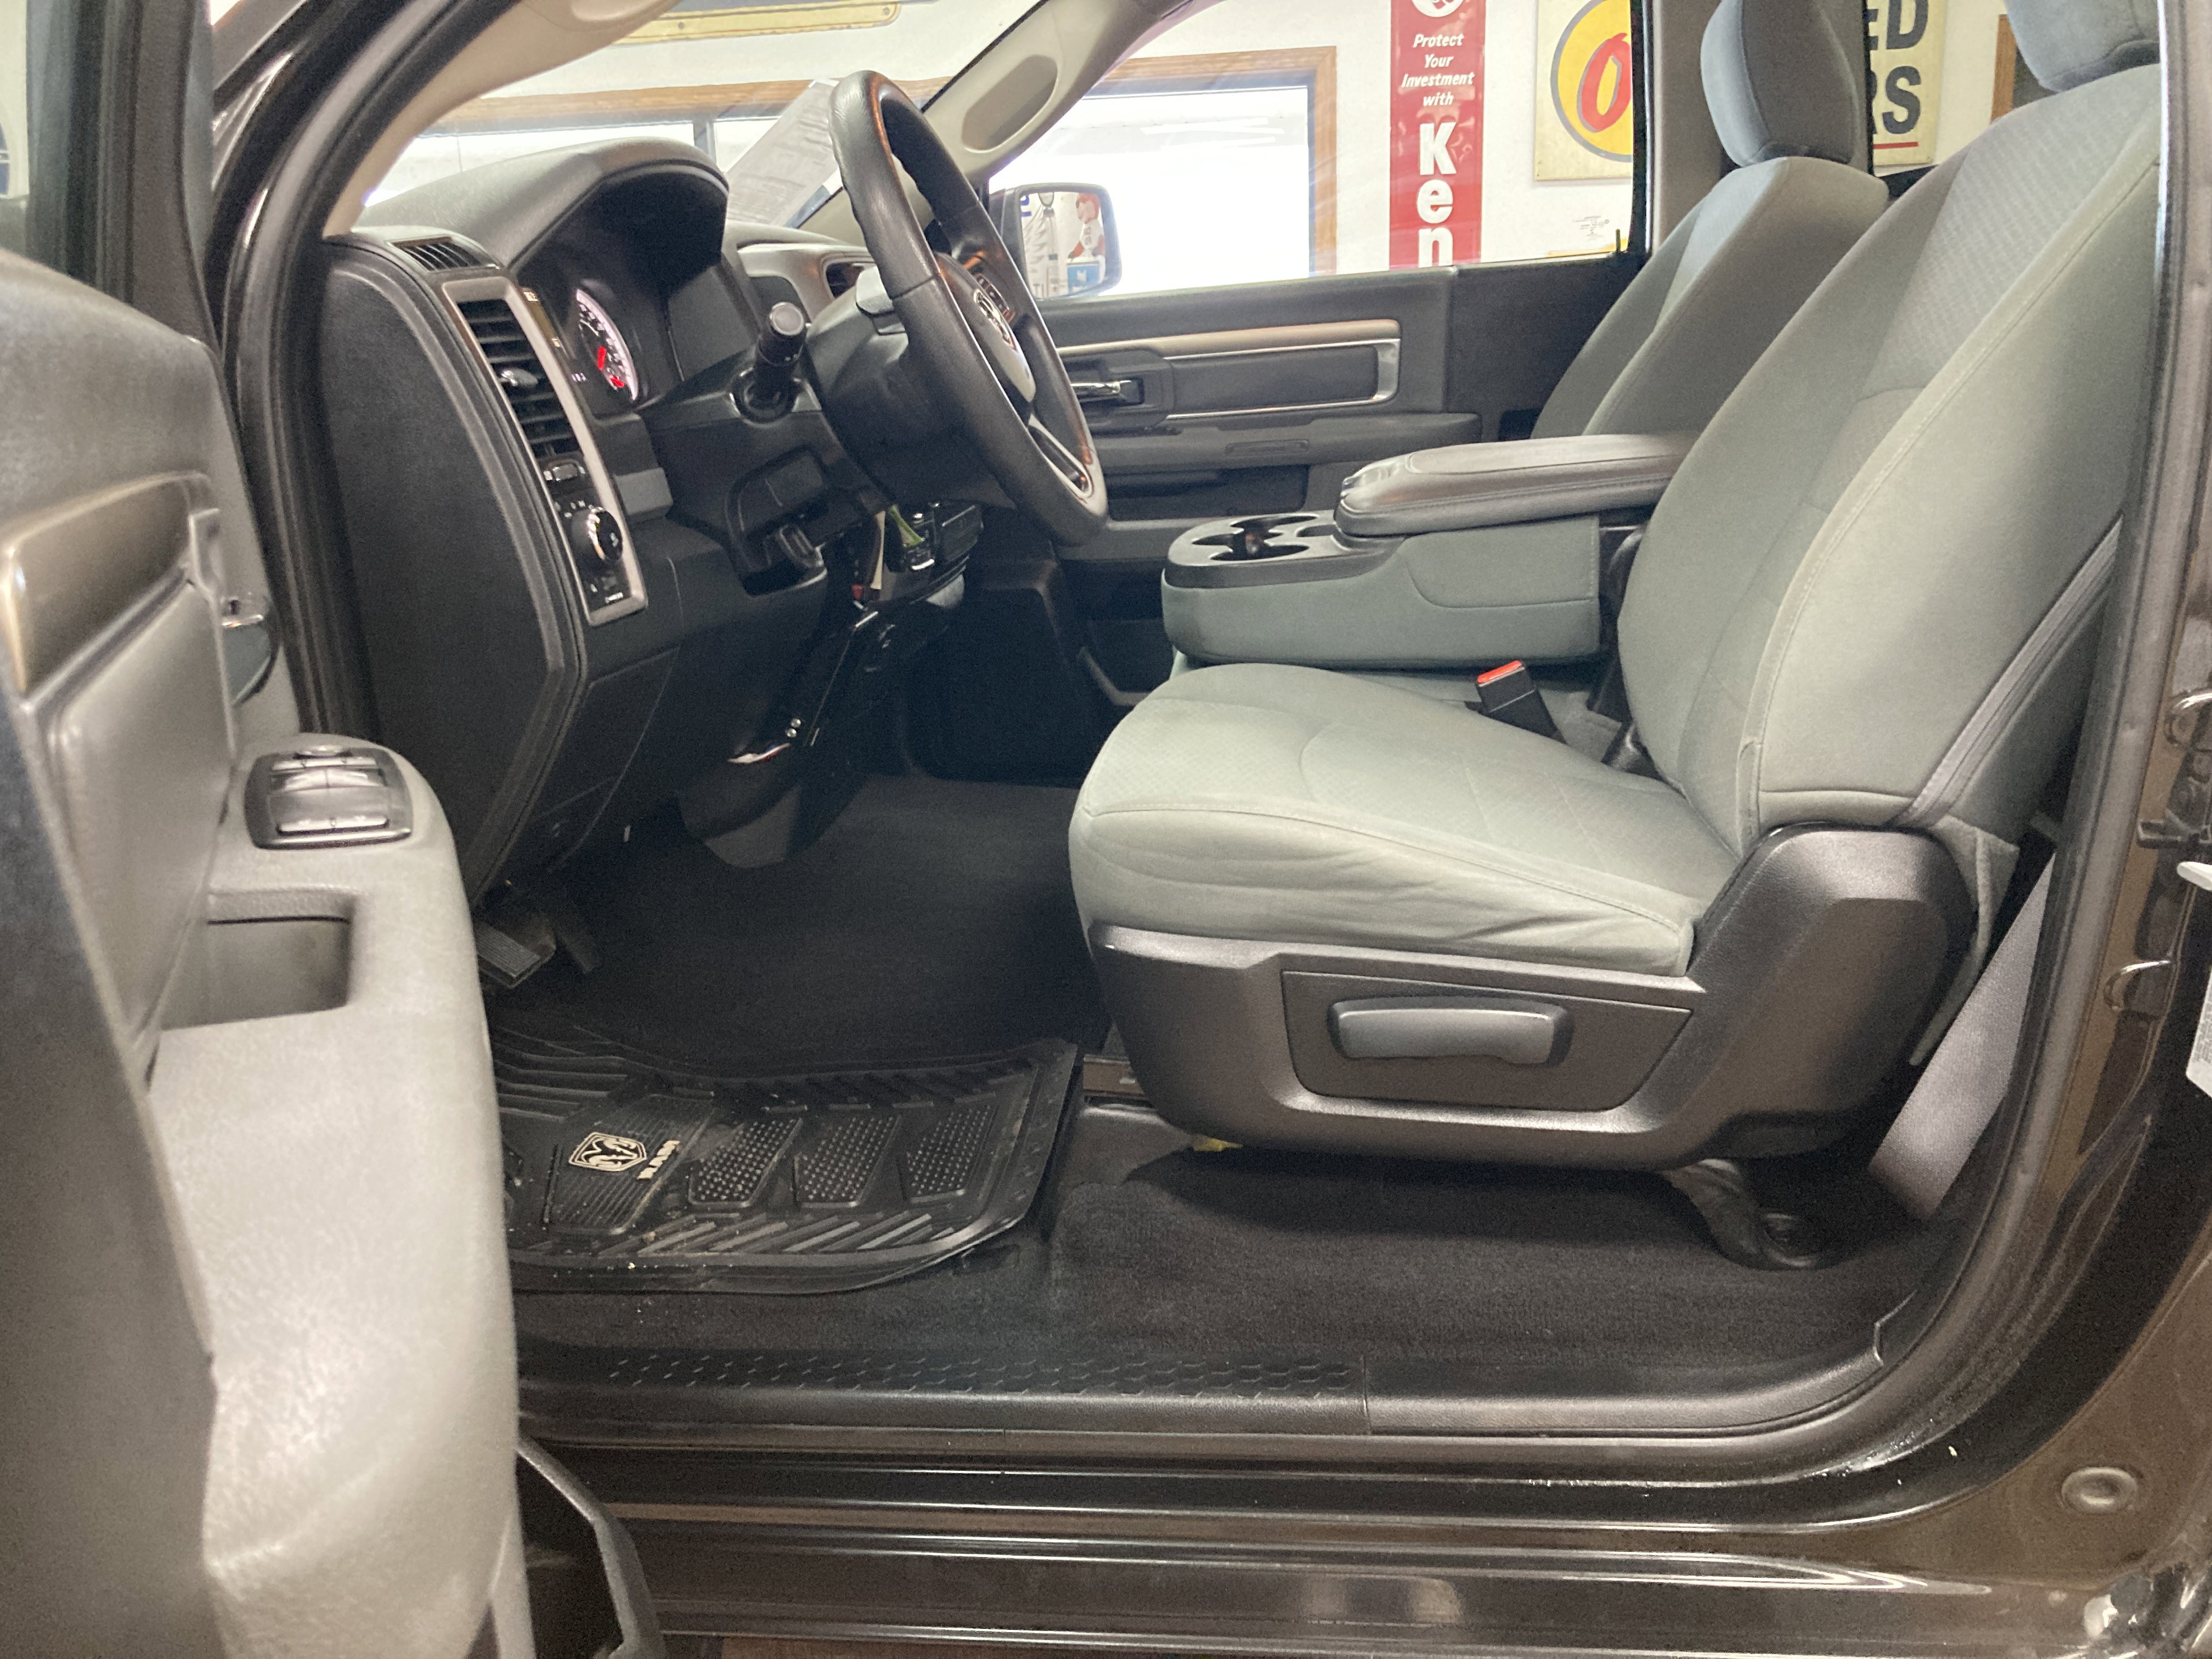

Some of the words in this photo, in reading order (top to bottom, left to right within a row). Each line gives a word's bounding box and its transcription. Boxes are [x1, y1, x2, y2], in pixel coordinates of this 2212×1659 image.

[1413, 33, 1464, 48] Protect
[1424, 53, 1454, 69] Your
[1401, 71, 1475, 88] Investment
[1423, 92, 1454, 107] with
[1870, 65, 1922, 134] S
[1417, 121, 1457, 268] Ken
